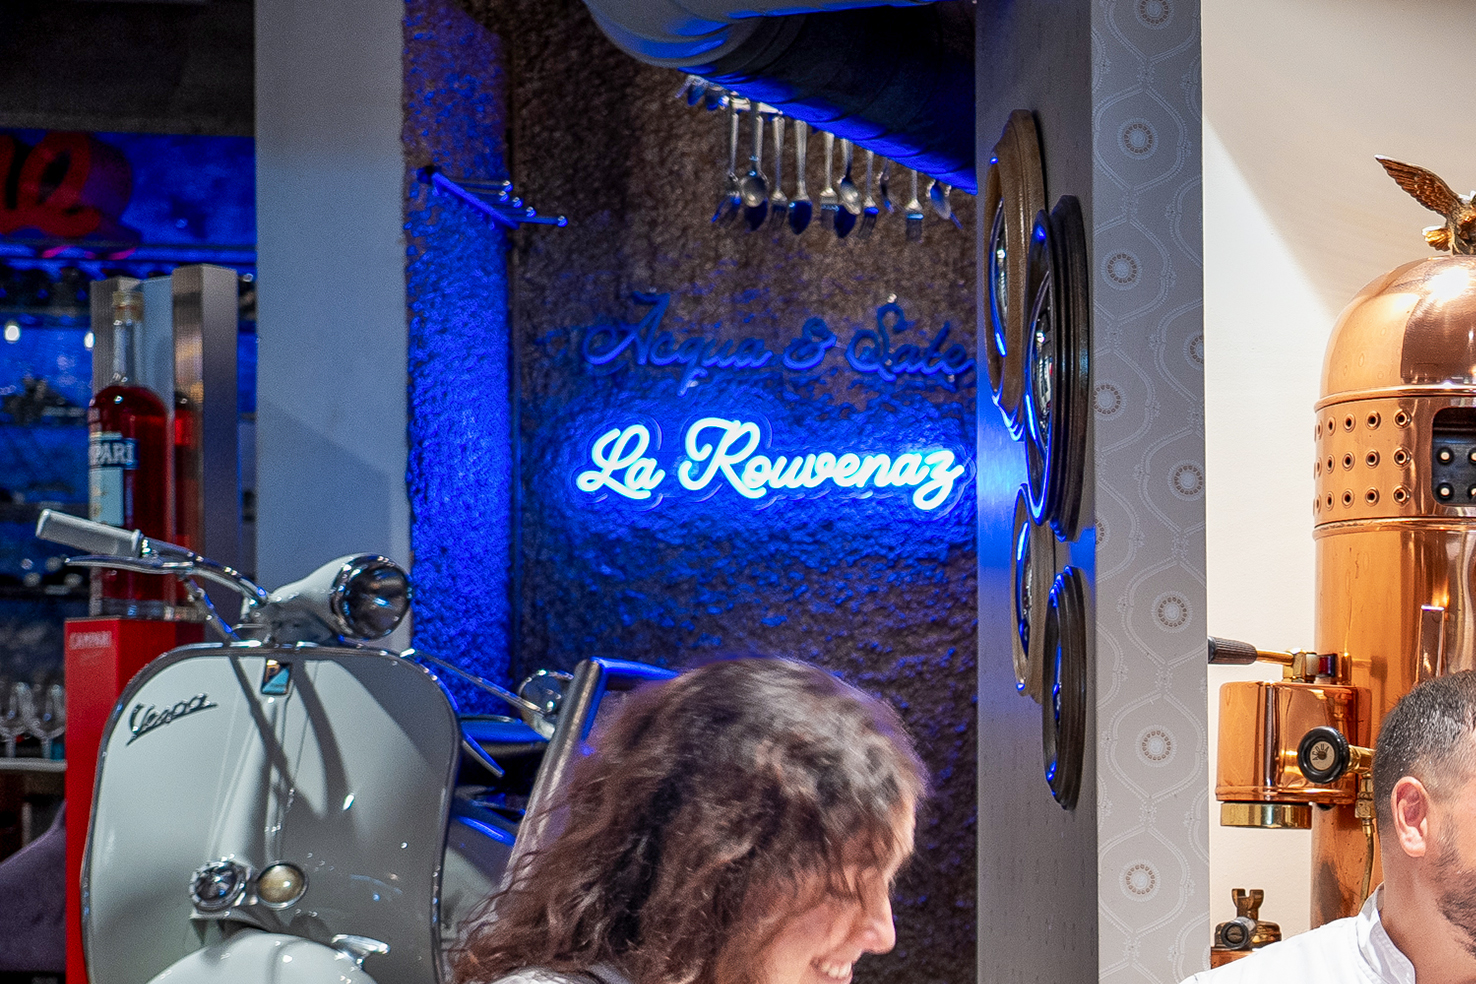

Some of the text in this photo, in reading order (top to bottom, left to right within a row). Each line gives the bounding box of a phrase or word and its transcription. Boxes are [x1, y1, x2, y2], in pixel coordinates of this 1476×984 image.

[583, 292, 772, 396] Acqua
[845, 303, 977, 381] Sale
[90, 440, 136, 466] PARI
[576, 417, 965, 511] La Rouvenaz
[127, 691, 219, 747] Vespa
[1311, 743, 1330, 761] ACQUA
